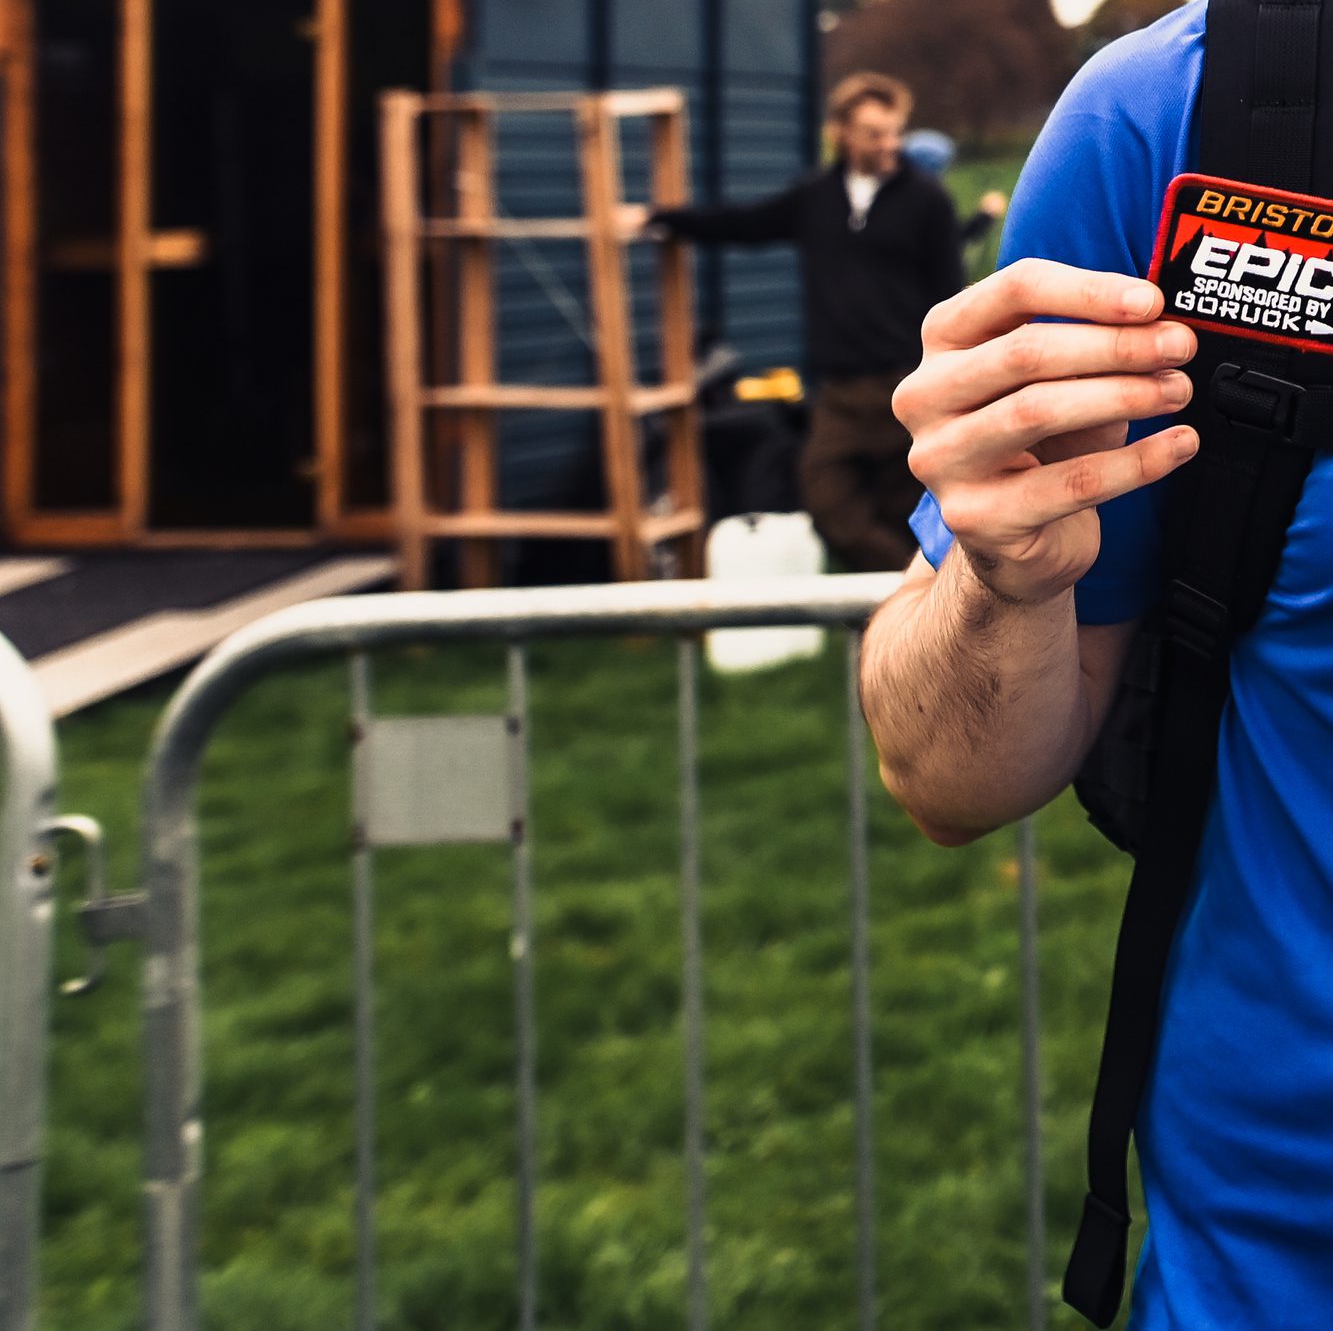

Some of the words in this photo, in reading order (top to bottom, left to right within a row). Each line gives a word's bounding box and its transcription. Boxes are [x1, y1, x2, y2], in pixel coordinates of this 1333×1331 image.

[1175, 290, 1301, 332] GORUCK
[1193, 277, 1301, 312] SPONSORED
[1305, 300, 1331, 318] BY
